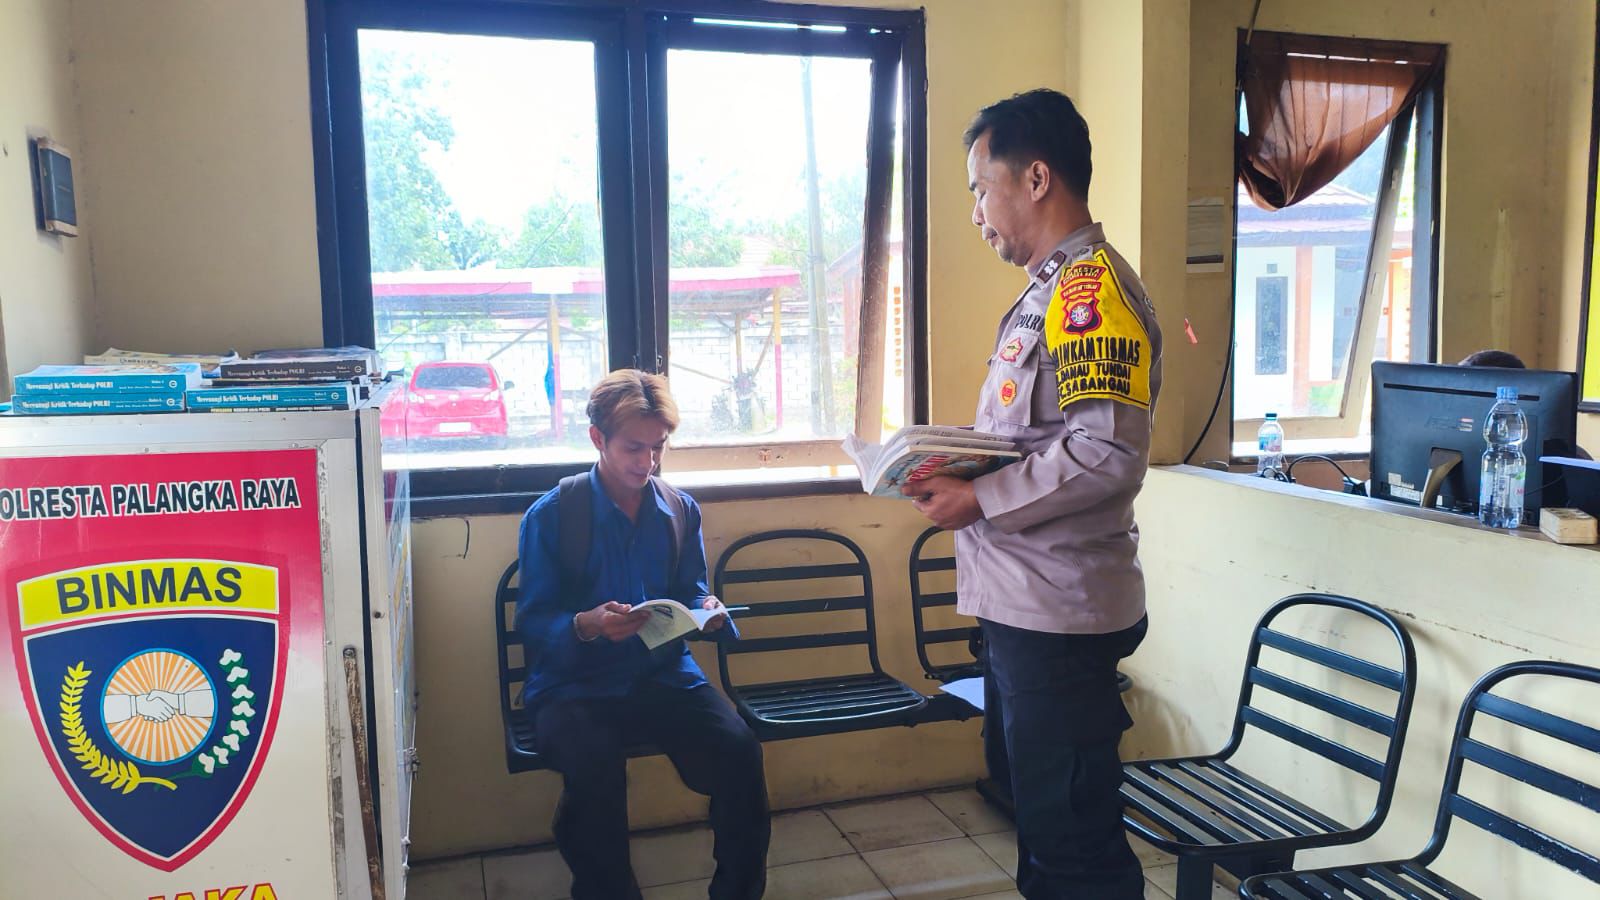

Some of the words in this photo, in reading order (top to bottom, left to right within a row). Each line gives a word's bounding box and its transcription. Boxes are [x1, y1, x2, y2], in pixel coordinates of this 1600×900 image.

[1095, 361, 1131, 380] TUNDAI
[111, 479, 238, 516] PALANGKA
[242, 477, 301, 510] RAYA
[56, 566, 242, 615] BINMAS
